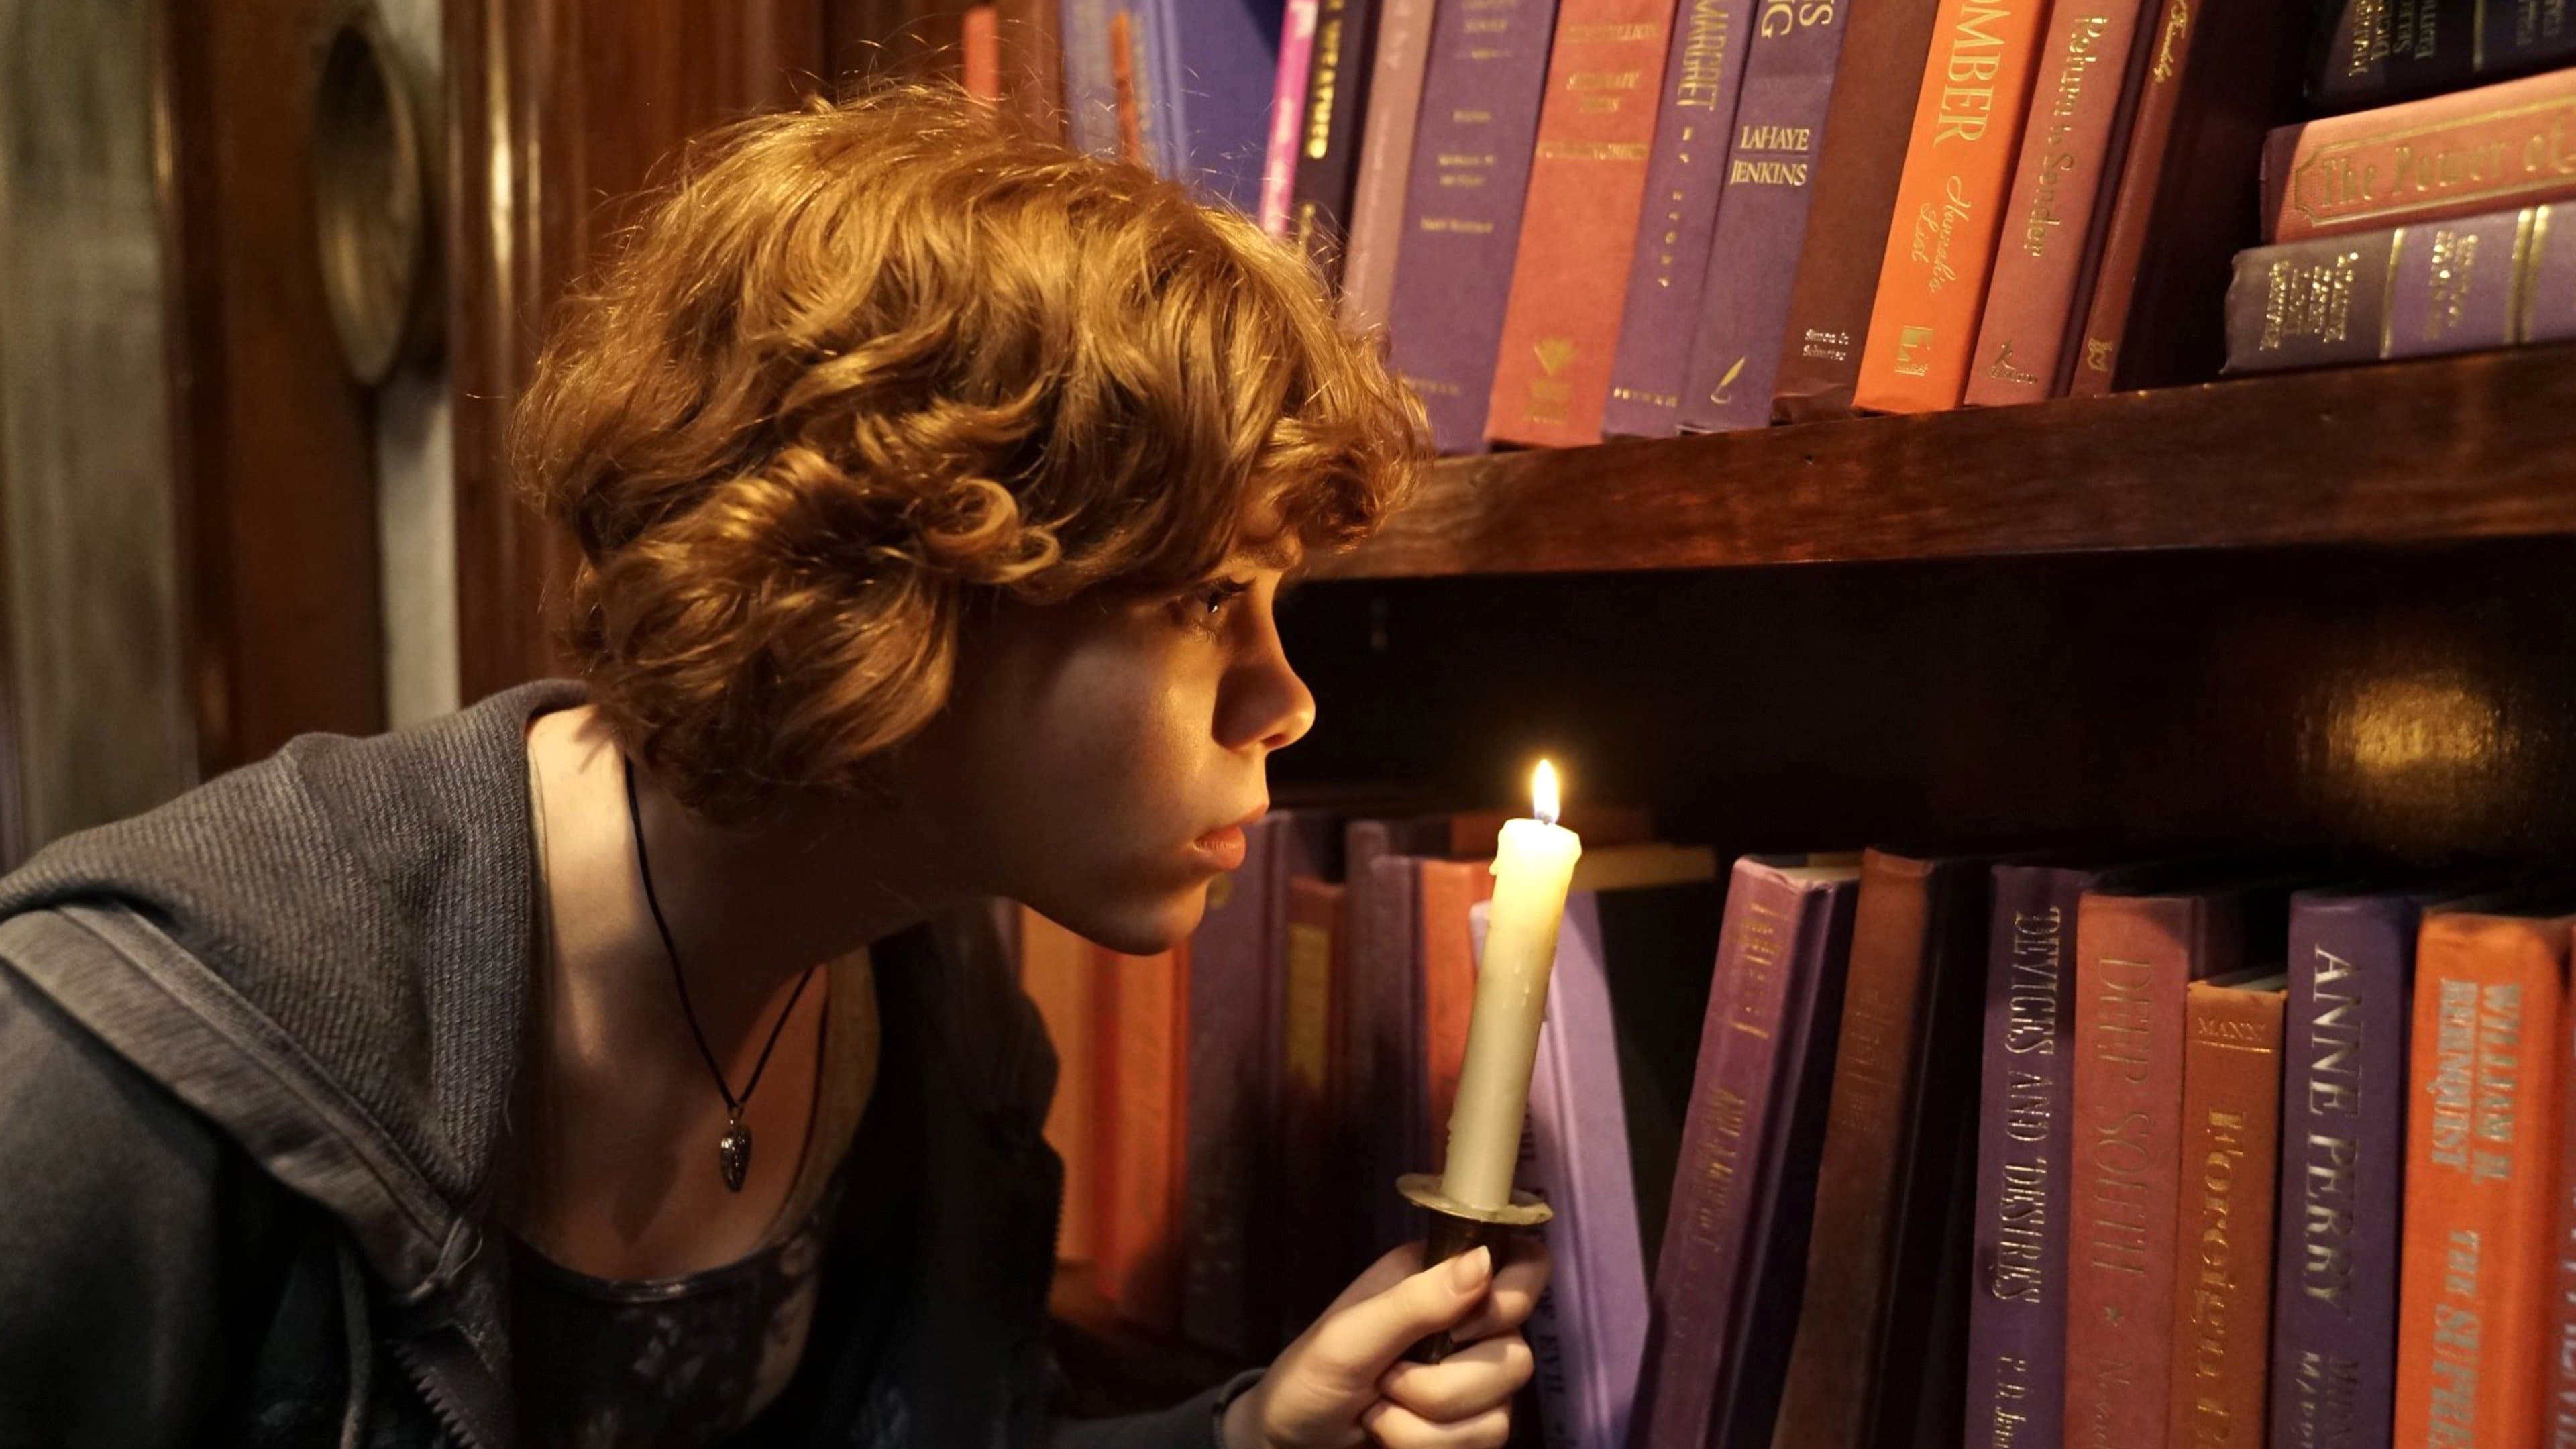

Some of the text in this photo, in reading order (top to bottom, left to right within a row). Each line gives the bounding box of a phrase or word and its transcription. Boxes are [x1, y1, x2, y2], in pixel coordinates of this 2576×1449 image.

[1730, 160, 1807, 186] JENKINS
[1912, 201, 1940, 263] List
[2023, 153, 2074, 258] Sender
[2322, 156, 2377, 207] The
[2097, 957, 2151, 1085] DEEP
[2426, 978, 2478, 1173] REHNQUIST
[2477, 984, 2521, 1144] WILLIAM
[1991, 904, 2060, 1305] DEVICES AND DESIRES
[2301, 943, 2364, 1322] ANNE PERRY
[2192, 1106, 2247, 1379] Foreign
[2446, 1230, 2480, 1297] THE
